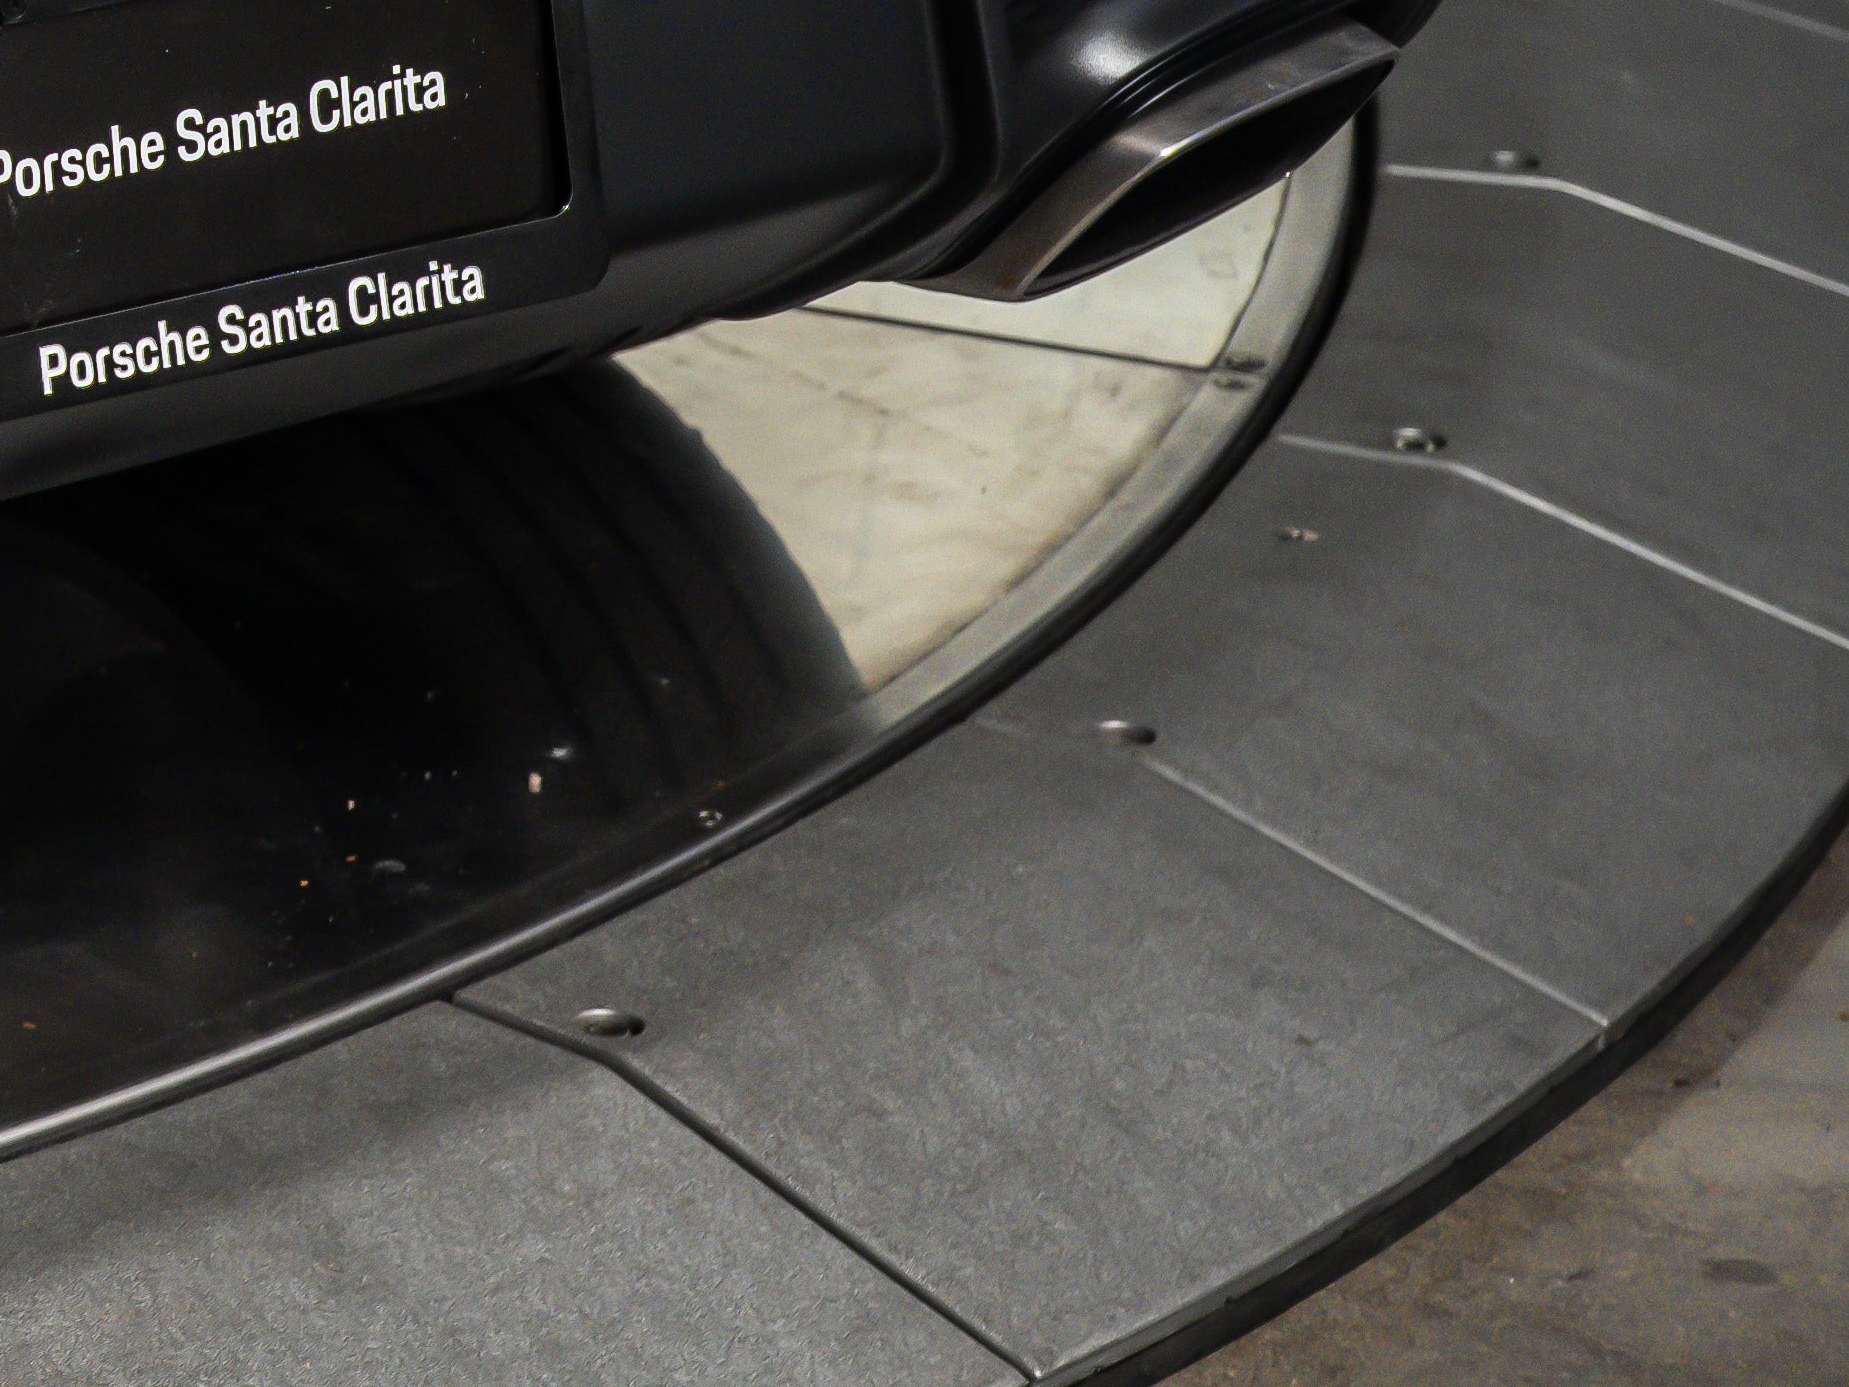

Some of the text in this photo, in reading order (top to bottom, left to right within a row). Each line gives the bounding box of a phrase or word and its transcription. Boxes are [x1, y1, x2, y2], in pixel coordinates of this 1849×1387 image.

[176, 98, 300, 163] Santa
[309, 63, 447, 133] Clarita
[38, 260, 486, 396] Porsche Santa Clarita
